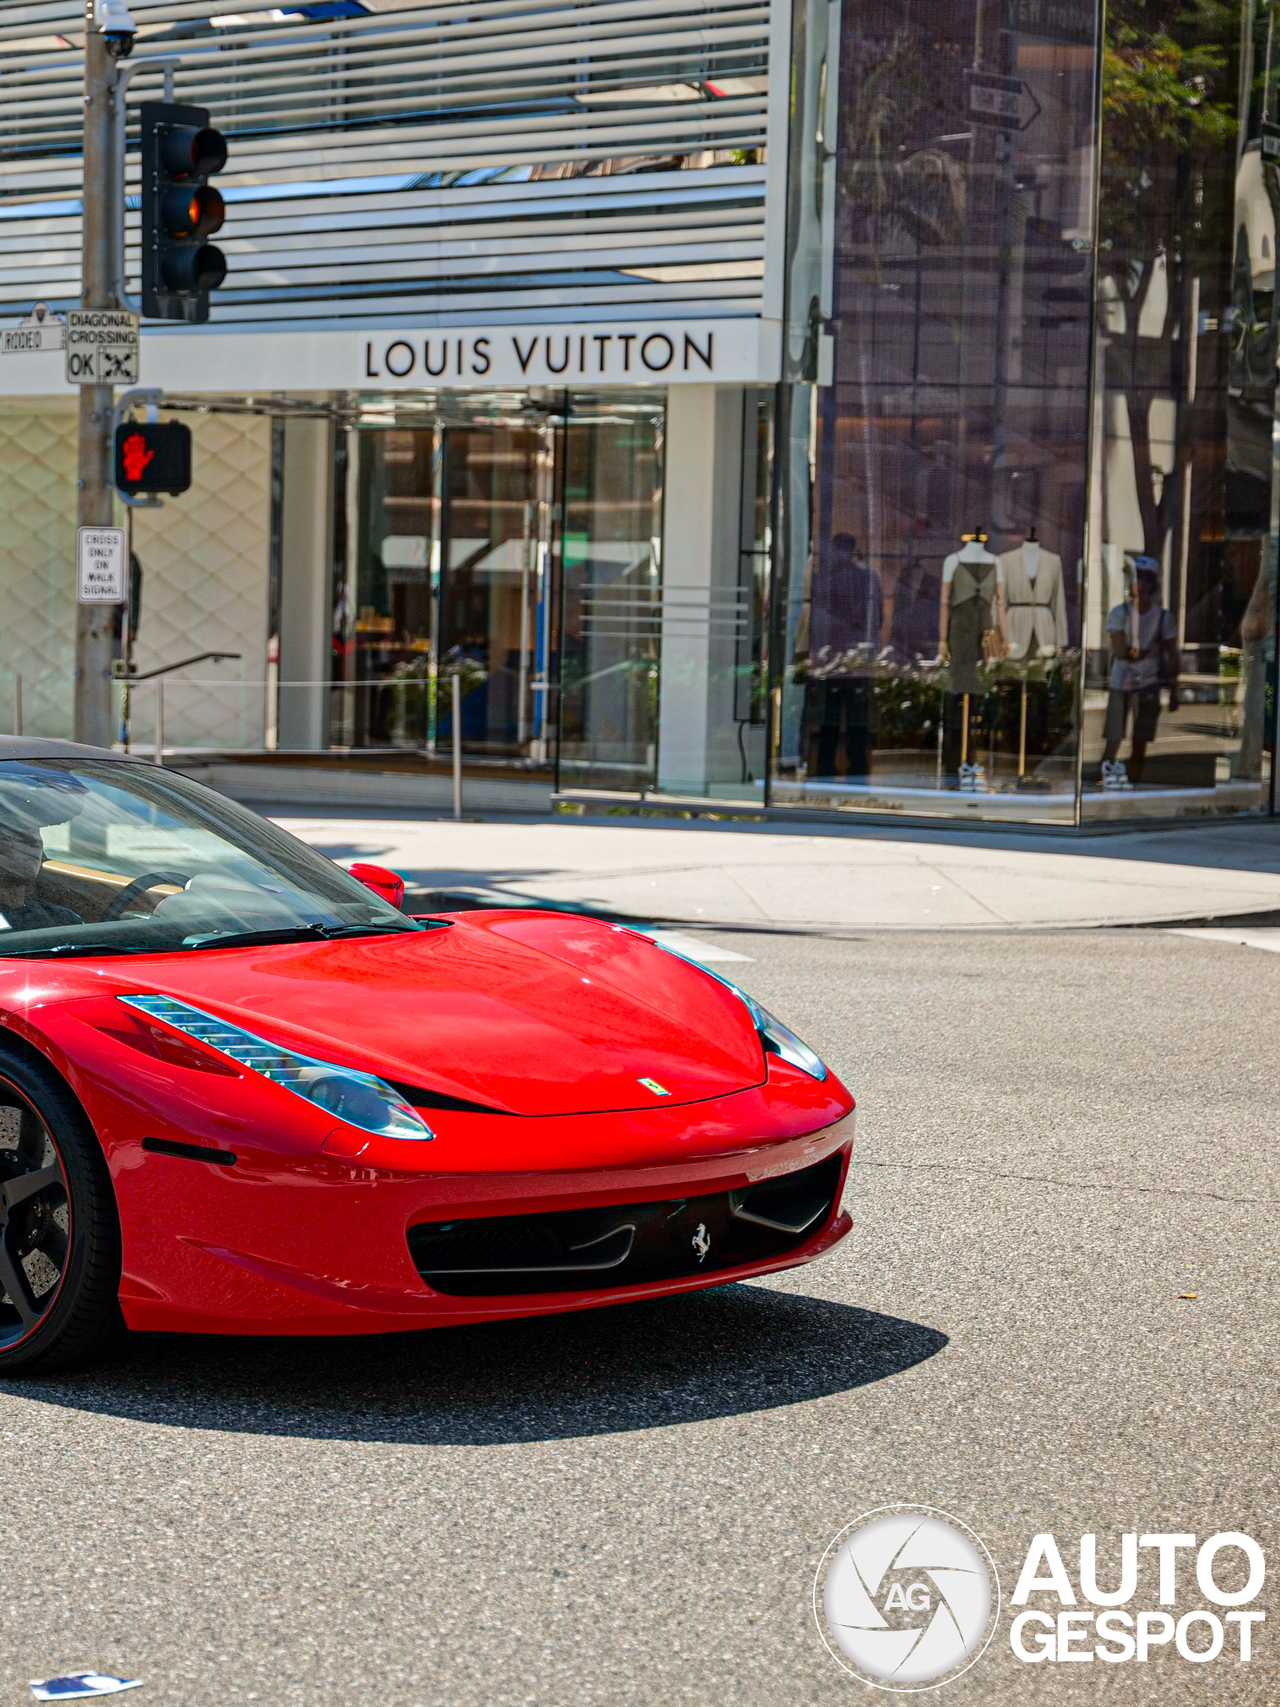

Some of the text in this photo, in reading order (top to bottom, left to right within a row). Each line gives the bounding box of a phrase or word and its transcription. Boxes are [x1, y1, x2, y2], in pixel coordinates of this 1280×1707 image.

[71, 313, 134, 327] DIAGONAL
[5, 331, 42, 350] RODEO
[70, 330, 136, 344] CROSSING
[366, 332, 713, 377] LOUIS VUITTON
[70, 352, 94, 376] OK
[85, 534, 119, 546] CROSS
[88, 547, 114, 558] ONLY
[94, 560, 109, 570] ON
[88, 573, 115, 582] WALK
[84, 584, 118, 595] SIGNAL
